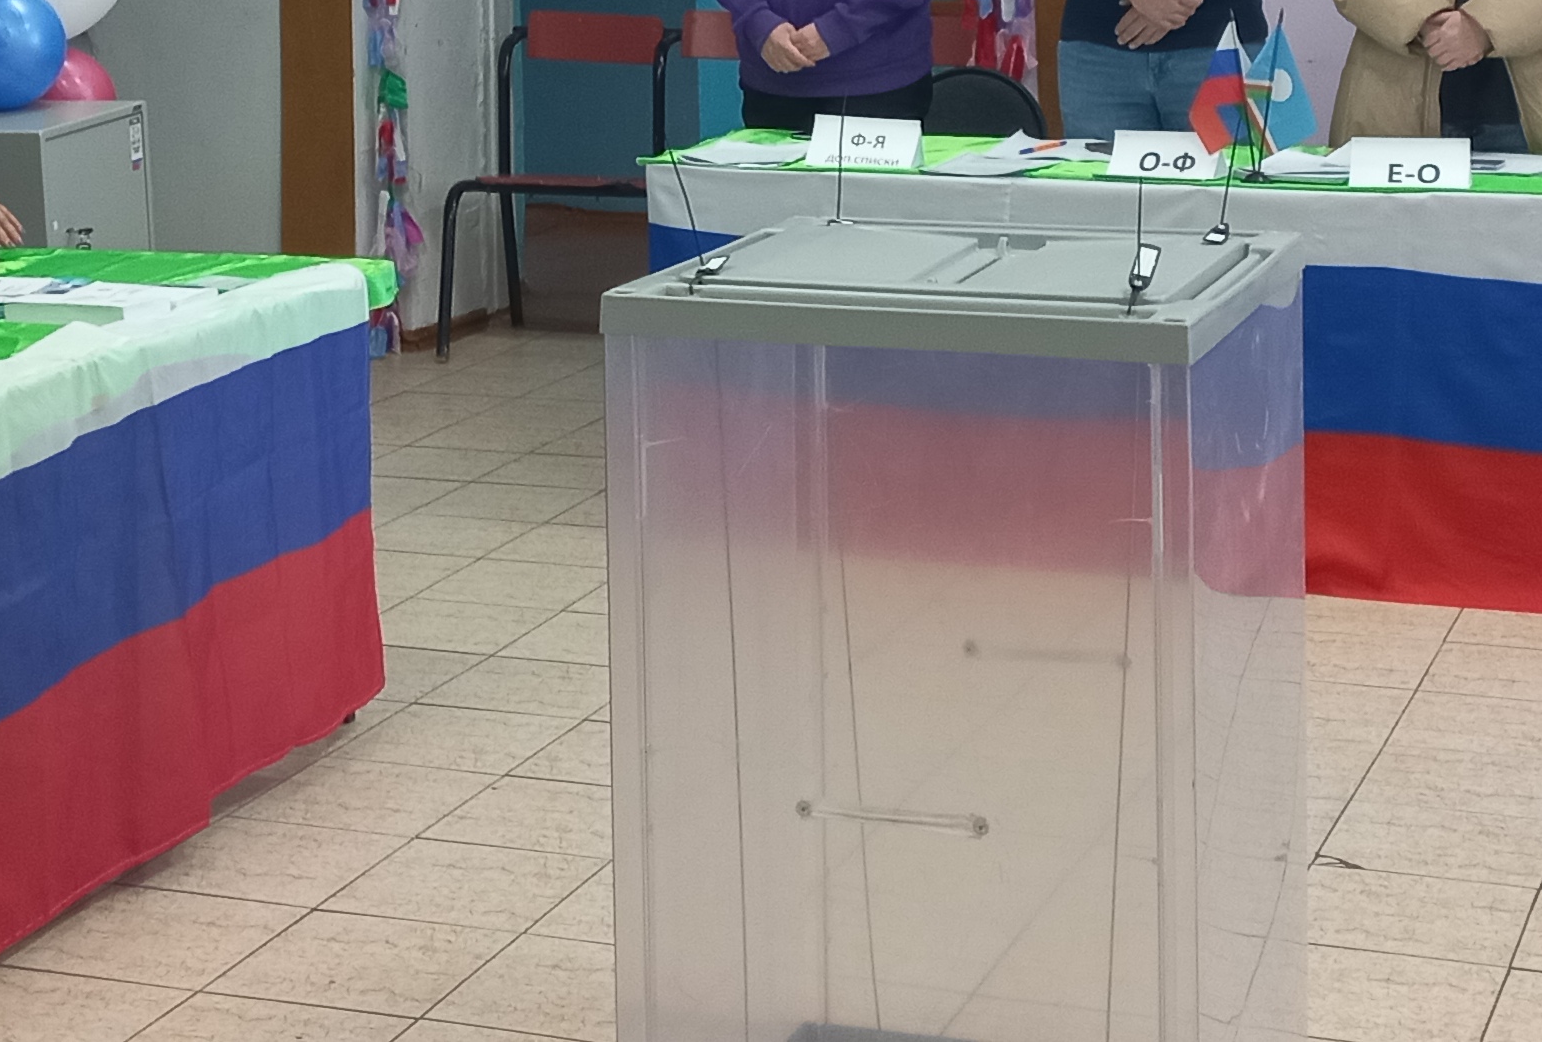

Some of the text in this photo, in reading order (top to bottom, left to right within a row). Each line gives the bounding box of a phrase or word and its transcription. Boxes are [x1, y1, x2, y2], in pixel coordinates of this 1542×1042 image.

[851, 132, 886, 149] Ф-Я
[1139, 152, 1196, 172] О-Ф
[1388, 163, 1440, 183] Е-О
